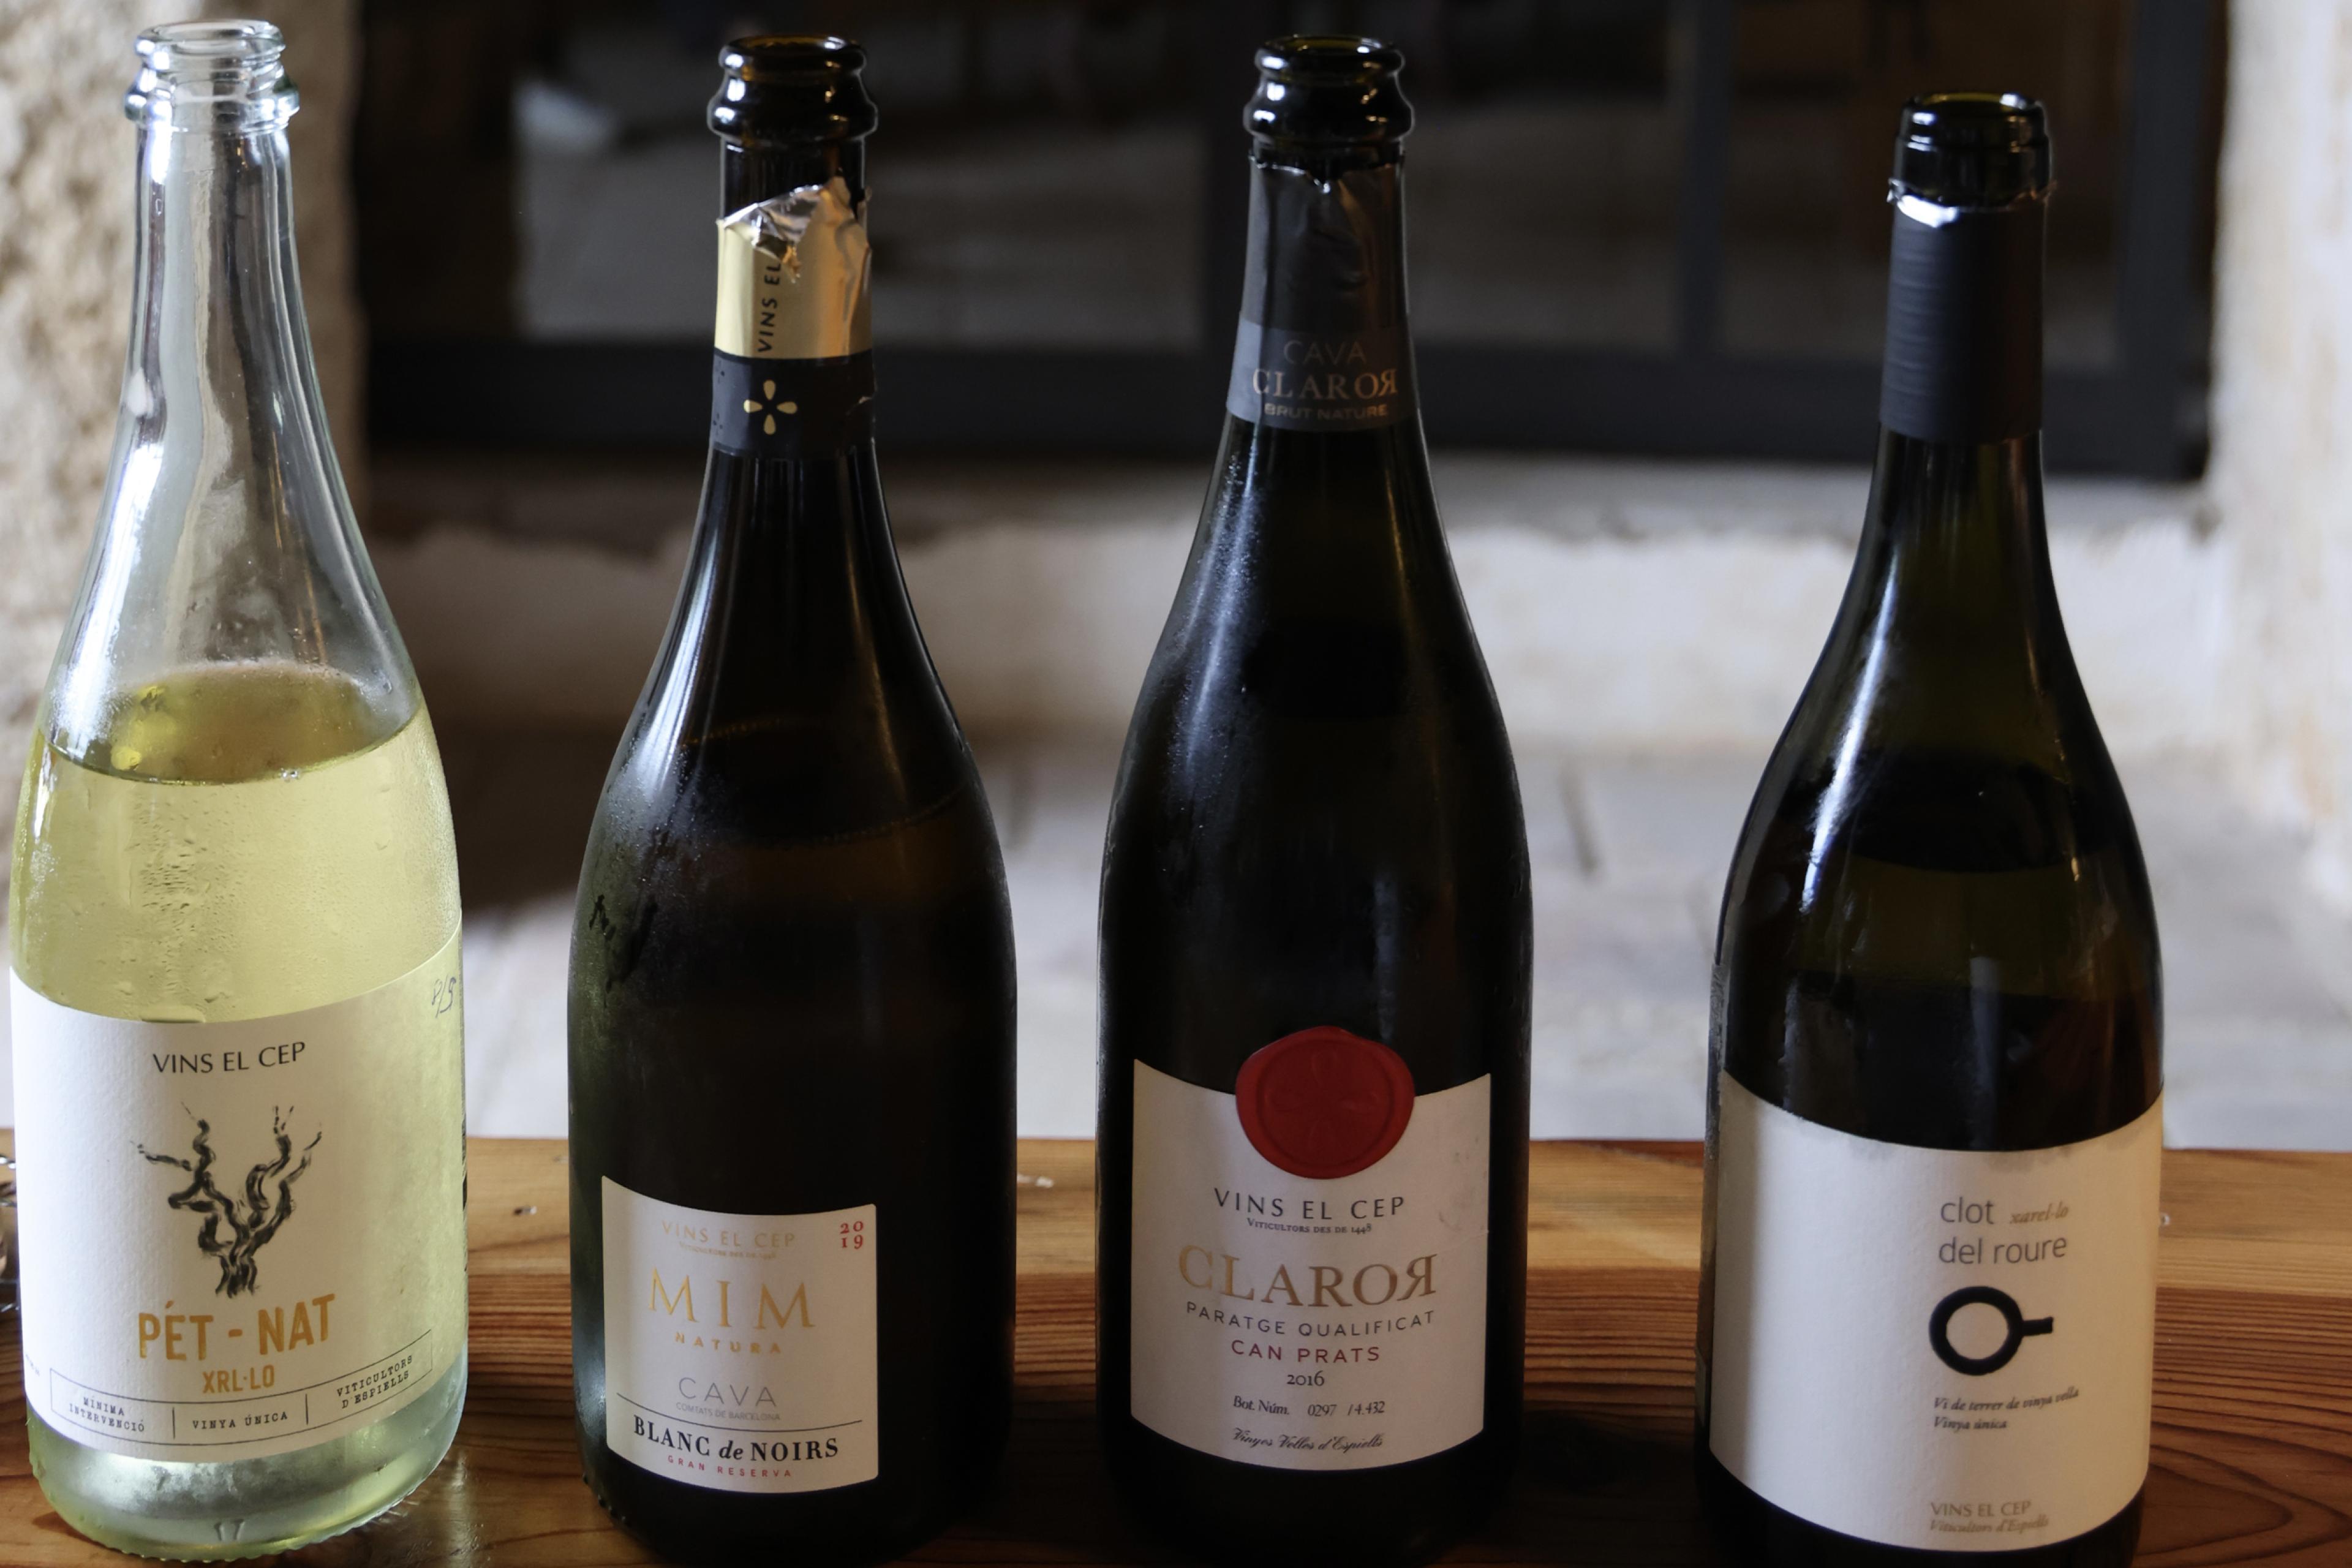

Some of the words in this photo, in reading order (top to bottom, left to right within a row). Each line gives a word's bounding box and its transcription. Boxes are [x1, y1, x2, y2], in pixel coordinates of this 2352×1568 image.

[758, 297, 778, 353] VINS
[1283, 339, 1366, 366] CAVA
[1264, 402, 1313, 419] BRUT
[1317, 404, 1388, 420] NATURE
[153, 1053, 213, 1074] VINS
[224, 1051, 249, 1071] EL
[259, 1041, 306, 1068] CEP
[1213, 1187, 1284, 1218] VINS
[1303, 1200, 1333, 1220] EL
[1351, 1196, 1404, 1220] CEP
[1940, 1196, 1994, 1224] clot
[662, 1219, 708, 1243] VINS
[720, 1231, 741, 1246] EL
[754, 1232, 795, 1248] CEP
[840, 1221, 864, 1234] 20
[841, 1235, 864, 1250] 19
[1939, 1237, 1983, 1264] del
[1994, 1237, 2067, 1265] roure
[648, 1267, 816, 1330] MIM
[138, 1301, 214, 1361] PÉT
[258, 1294, 336, 1355] NAT
[1186, 1301, 1286, 1335] PARATGE
[1299, 1310, 1434, 1338] QUALIFICAT
[676, 1332, 782, 1354] NATURA
[1231, 1340, 1283, 1362] CAN
[1298, 1347, 1381, 1363] PRATS
[337, 1355, 413, 1397] VITICULTORS
[1287, 1370, 1325, 1386] 2016
[83, 1395, 124, 1415] MÍNIMA
[679, 1377, 777, 1407] CAVA
[1934, 1397, 1948, 1409] Vi
[1951, 1398, 1965, 1410] de
[2006, 1396, 2020, 1409] de
[2056, 1386, 2079, 1402] vella
[69, 1403, 145, 1432] INTERVENCIÓ
[1234, 1395, 1254, 1411] Bot.
[1258, 1400, 1289, 1415] Núm.
[1307, 1404, 1337, 1417] 0297
[193, 1419, 236, 1430] VINYA
[245, 1411, 288, 1427] ÚNICA
[1934, 1416, 1970, 1433] Vinya
[634, 1415, 710, 1457] BLANC
[719, 1440, 744, 1461] de
[750, 1438, 839, 1461] NOIRS
[668, 1455, 705, 1471] GRAN
[717, 1465, 792, 1477] RESERVA
[1931, 1502, 1972, 1517] VINS
[1978, 1504, 1994, 1517] EL
[2000, 1500, 2032, 1516] CEP
